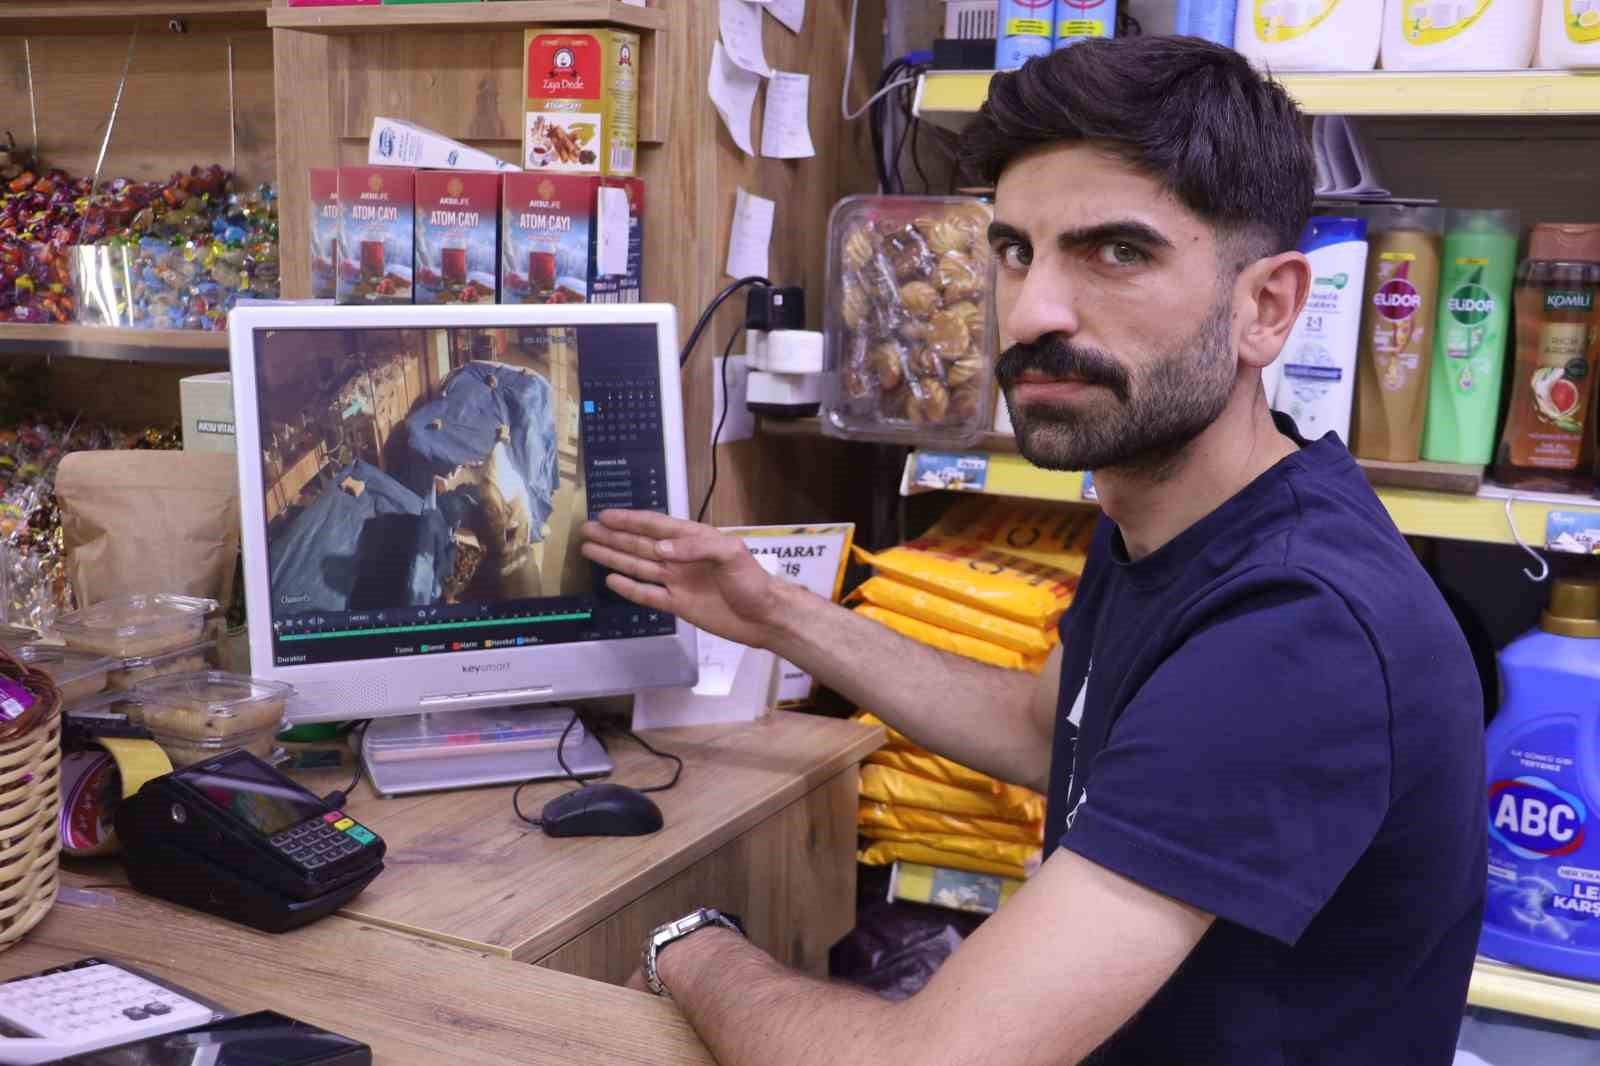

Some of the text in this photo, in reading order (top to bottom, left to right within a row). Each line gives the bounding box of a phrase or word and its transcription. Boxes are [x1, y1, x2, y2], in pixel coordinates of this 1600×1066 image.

[352, 205, 375, 220] ATOM
[431, 211, 456, 226] ATOM
[520, 213, 546, 230] ATOM
[198, 422, 217, 433] AKSU
[1494, 793, 1576, 842] ABC
[1573, 883, 1600, 900] LE
